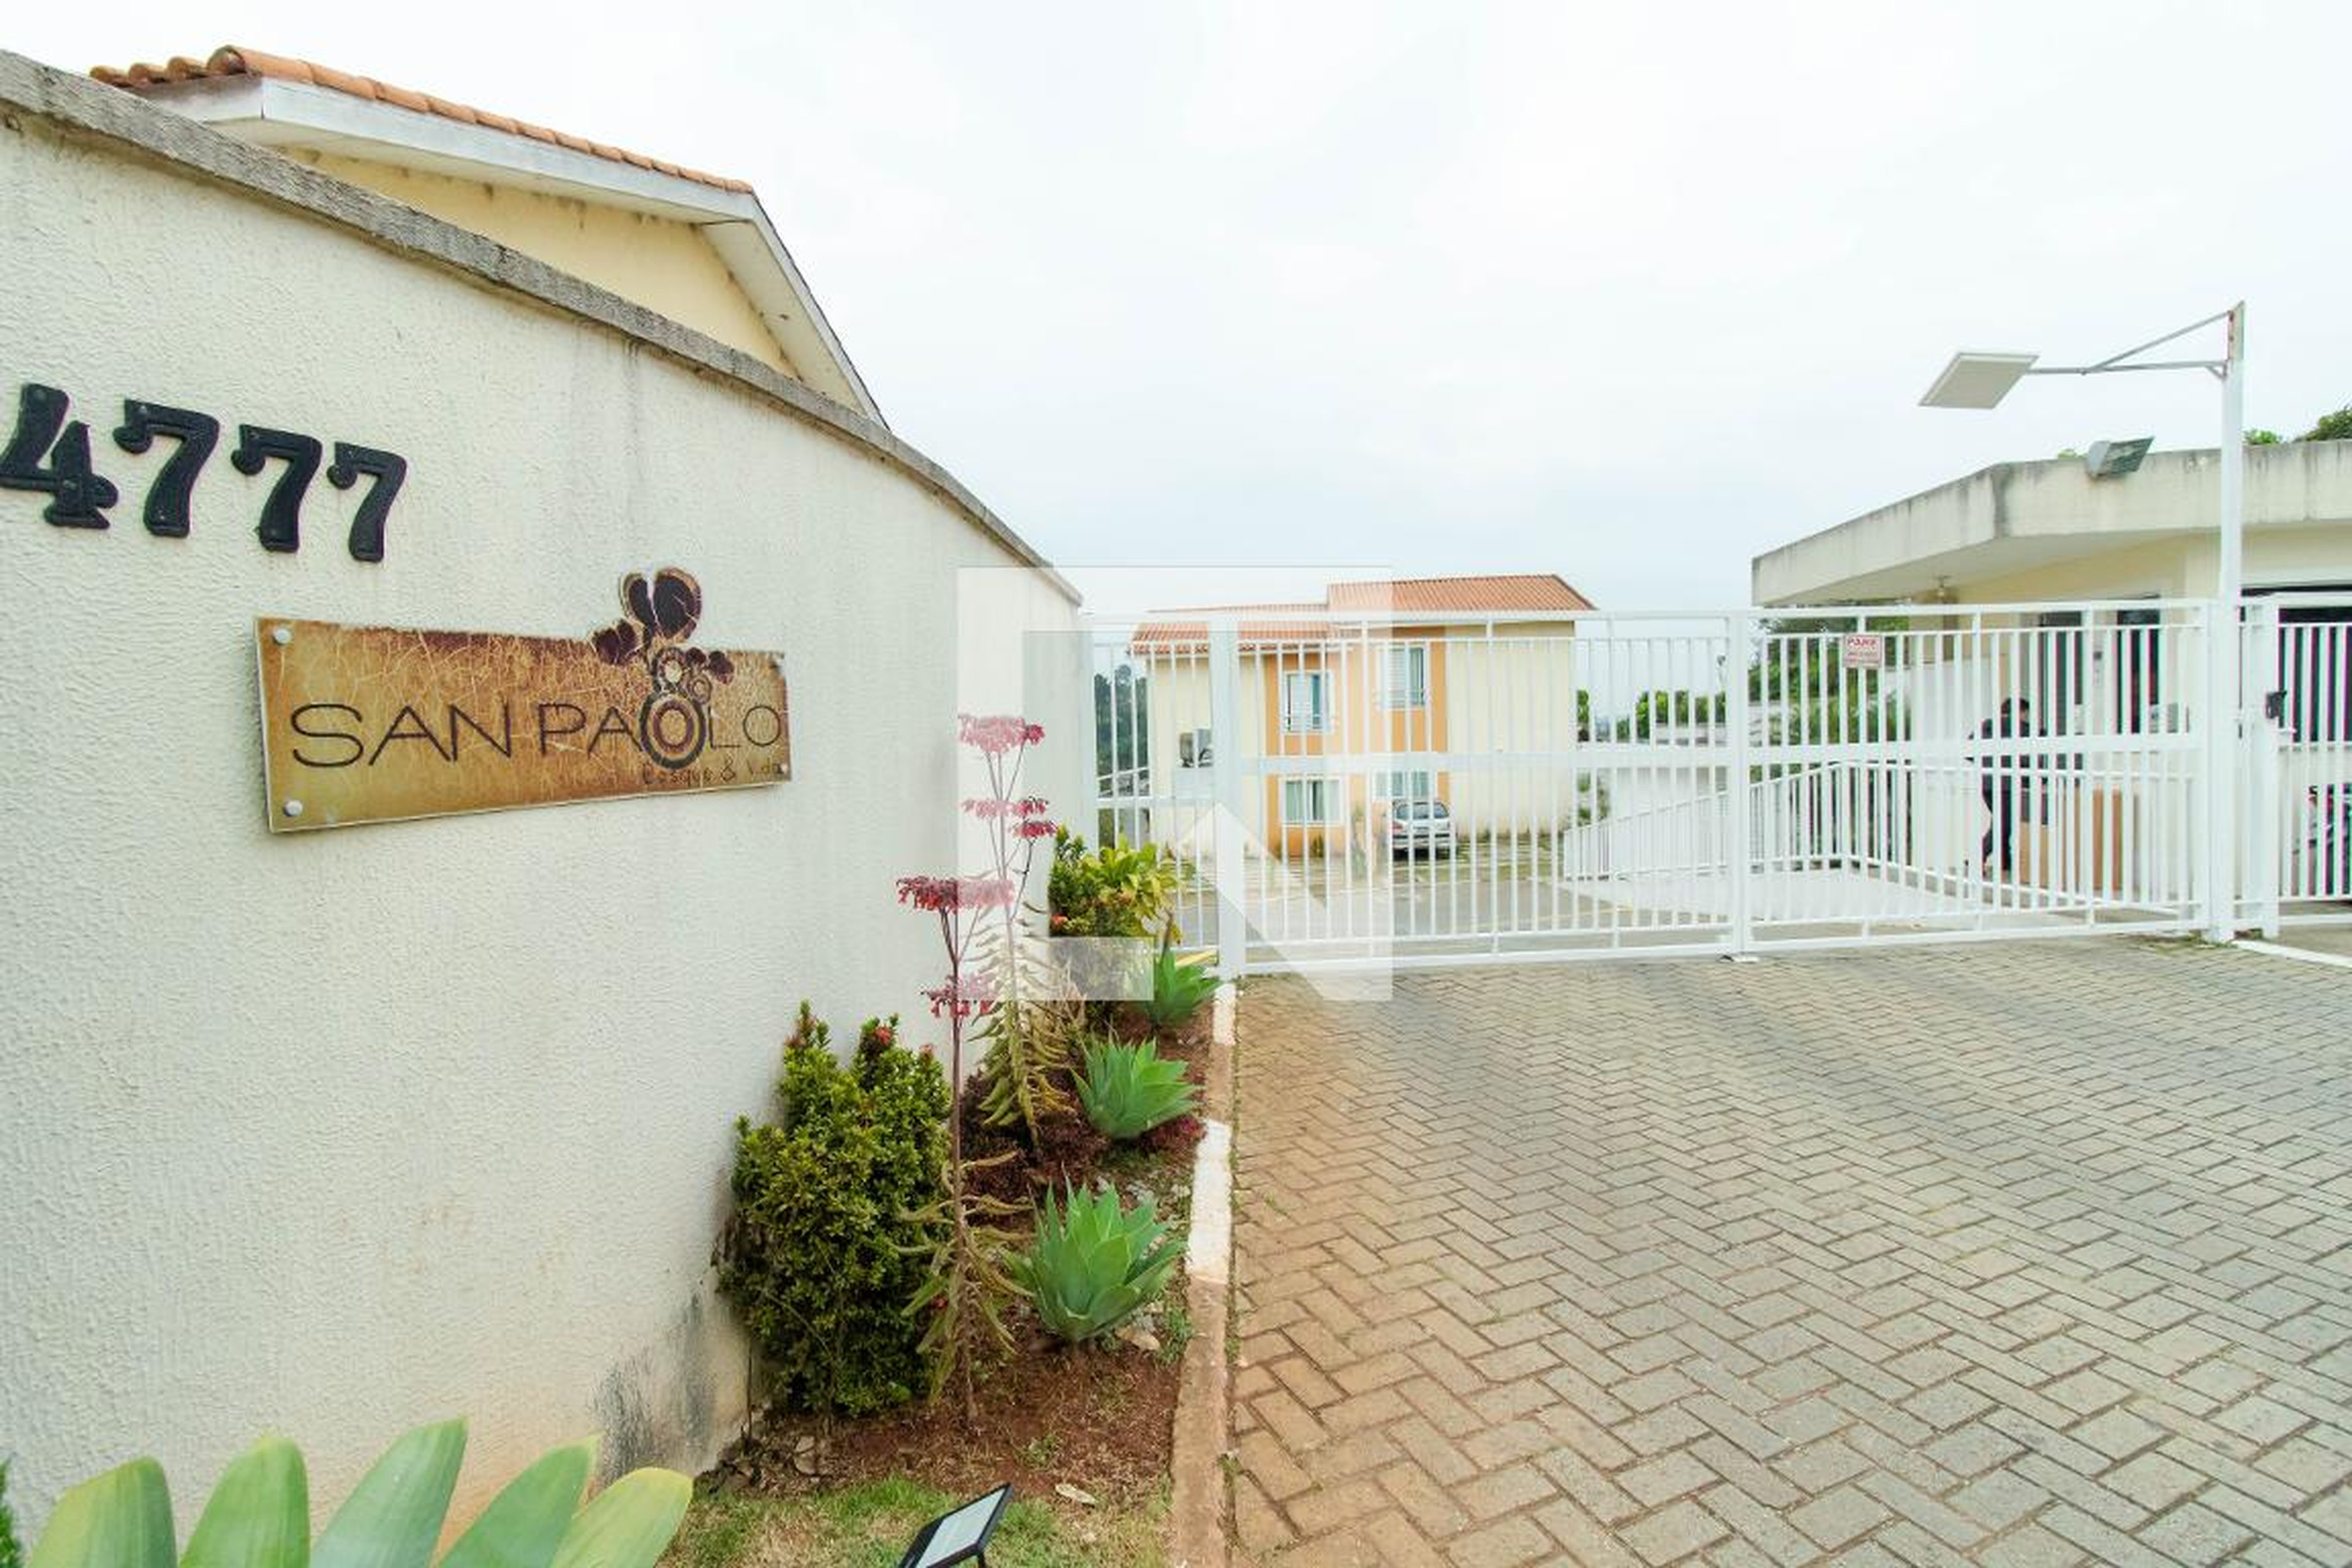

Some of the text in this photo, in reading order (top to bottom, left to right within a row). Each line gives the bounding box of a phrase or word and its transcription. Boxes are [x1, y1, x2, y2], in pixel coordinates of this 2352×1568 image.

[0, 383, 407, 564] 4777
[290, 690, 782, 769] SAN PAOLO
